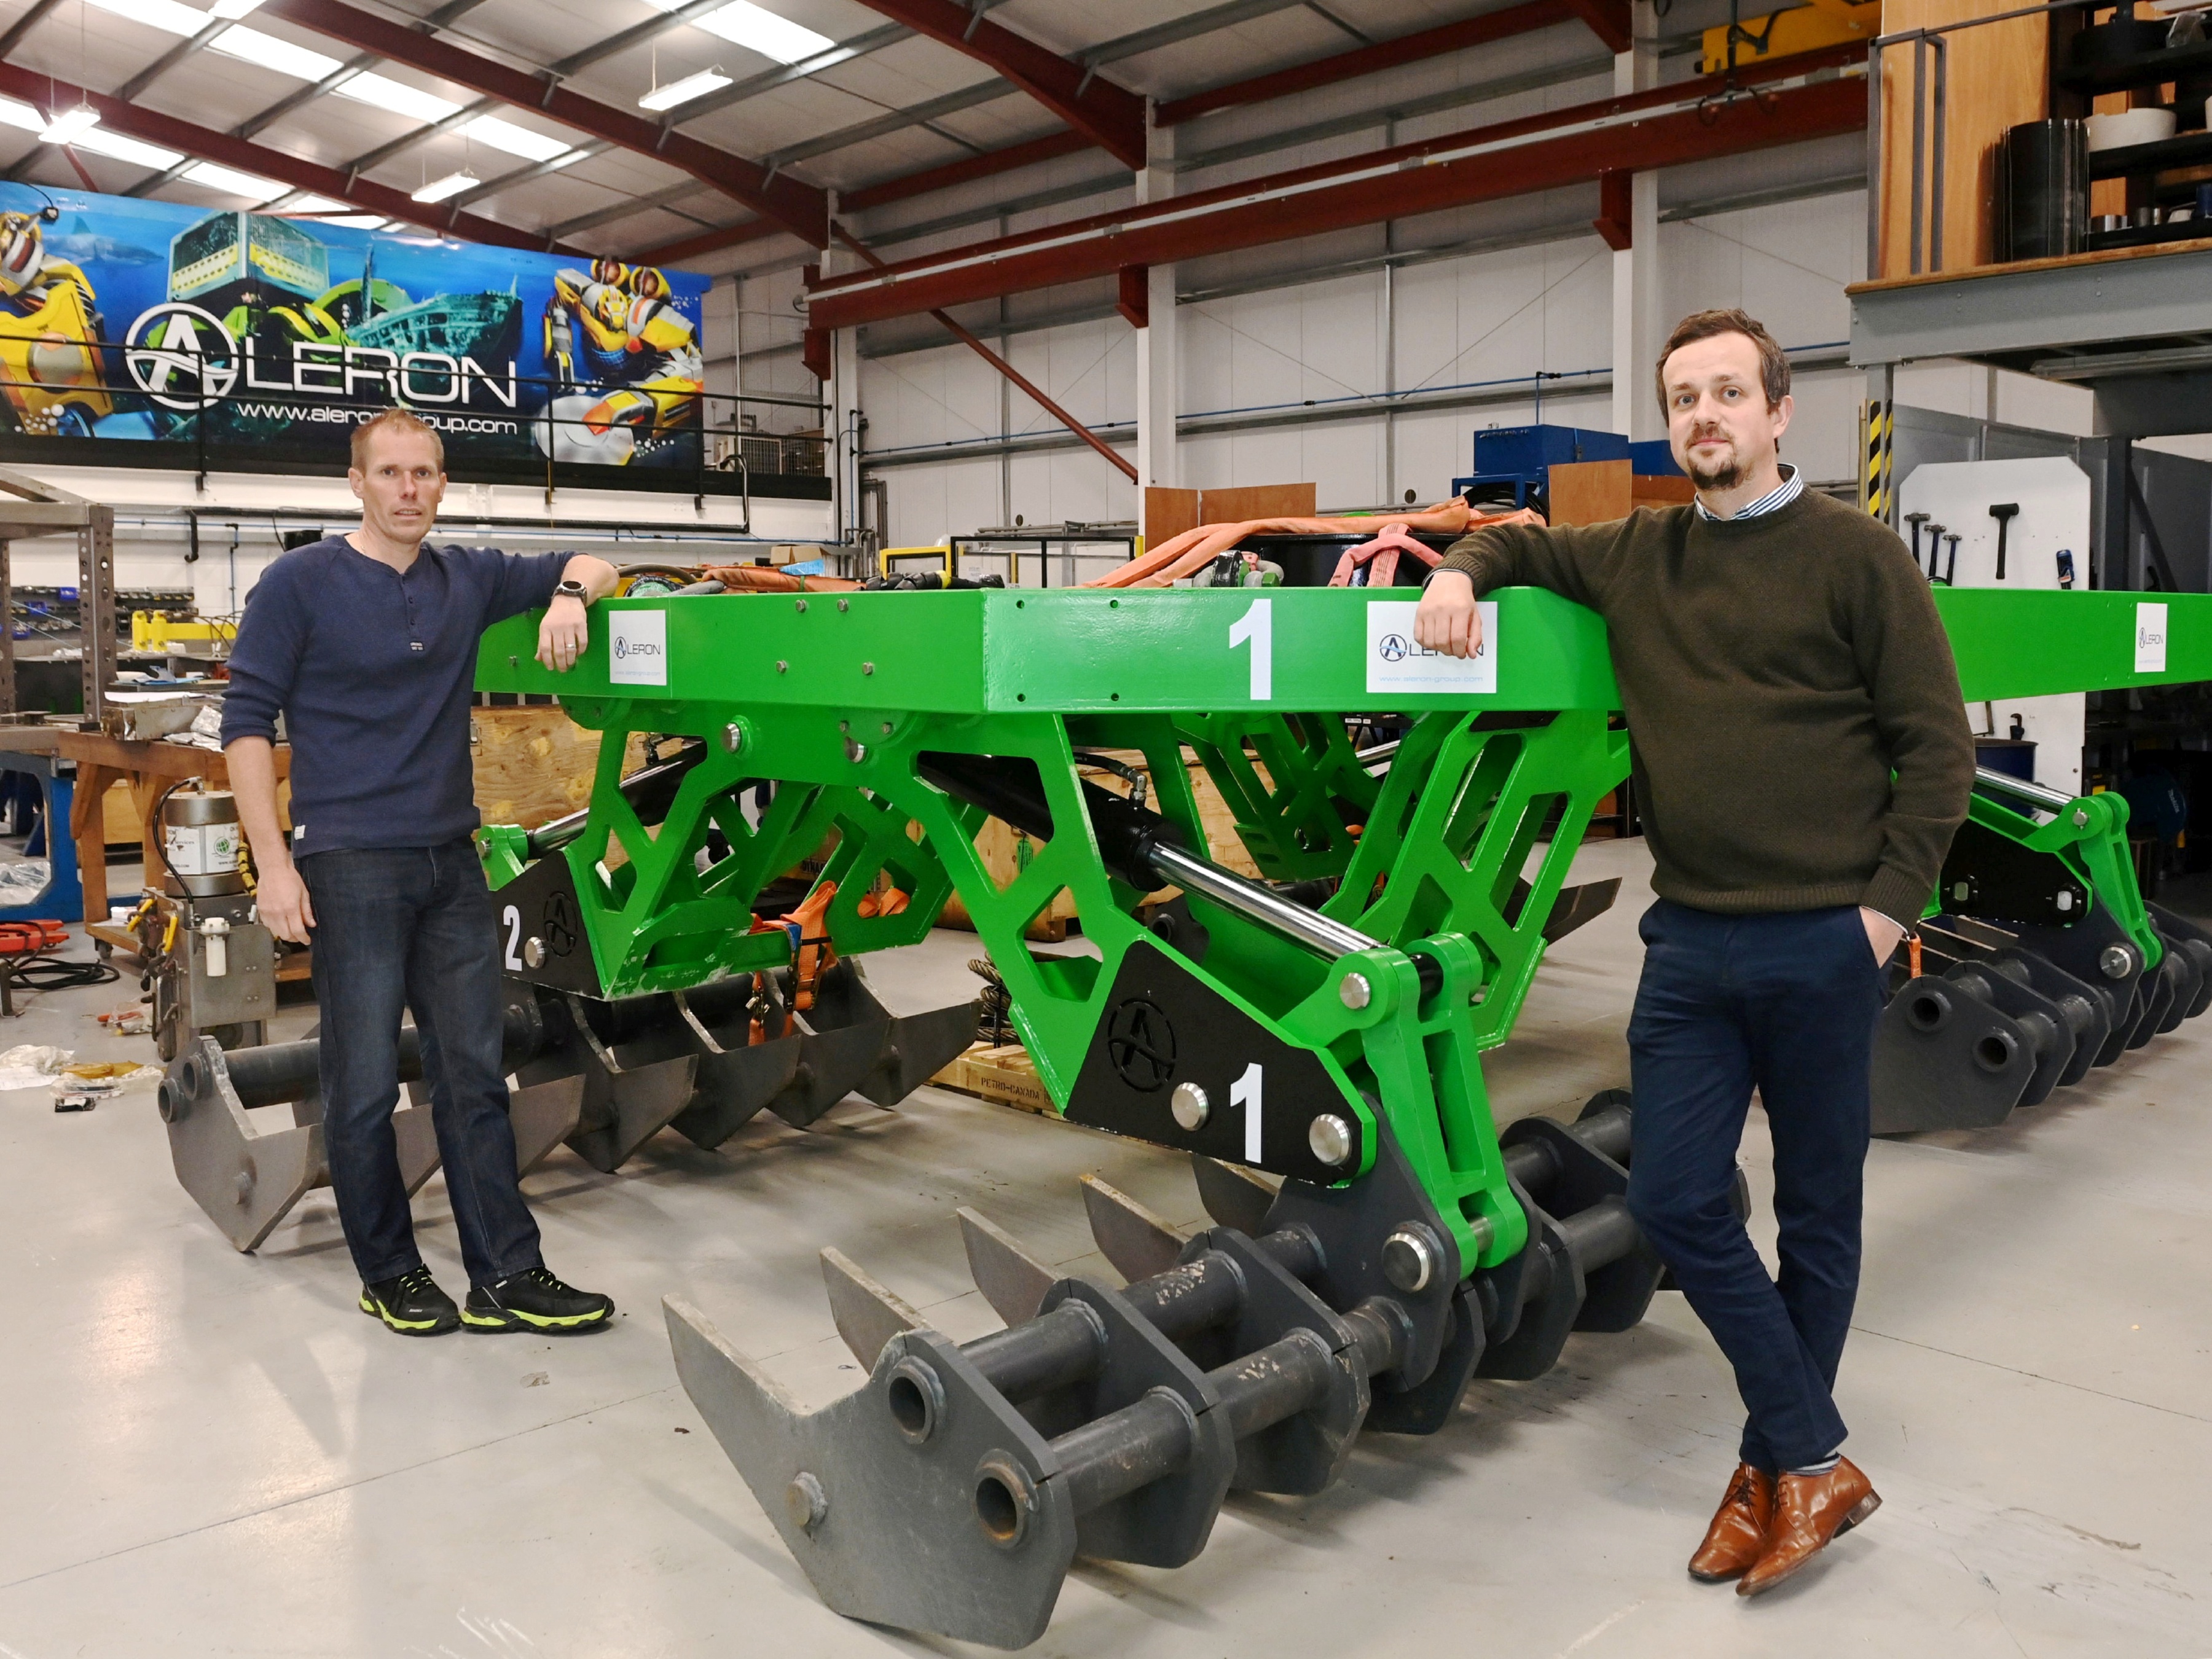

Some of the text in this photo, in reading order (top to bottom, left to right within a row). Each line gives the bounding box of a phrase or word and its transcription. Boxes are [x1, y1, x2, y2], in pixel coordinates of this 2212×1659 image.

[126, 303, 517, 410] ALERON
[614, 636, 661, 659] ALERON
[1230, 598, 1271, 700] 1
[2139, 627, 2163, 648] ALERON
[503, 904, 522, 971] 2
[981, 1077, 1040, 1100] PETRO-CANADA
[1230, 1062, 1262, 1164] 1
